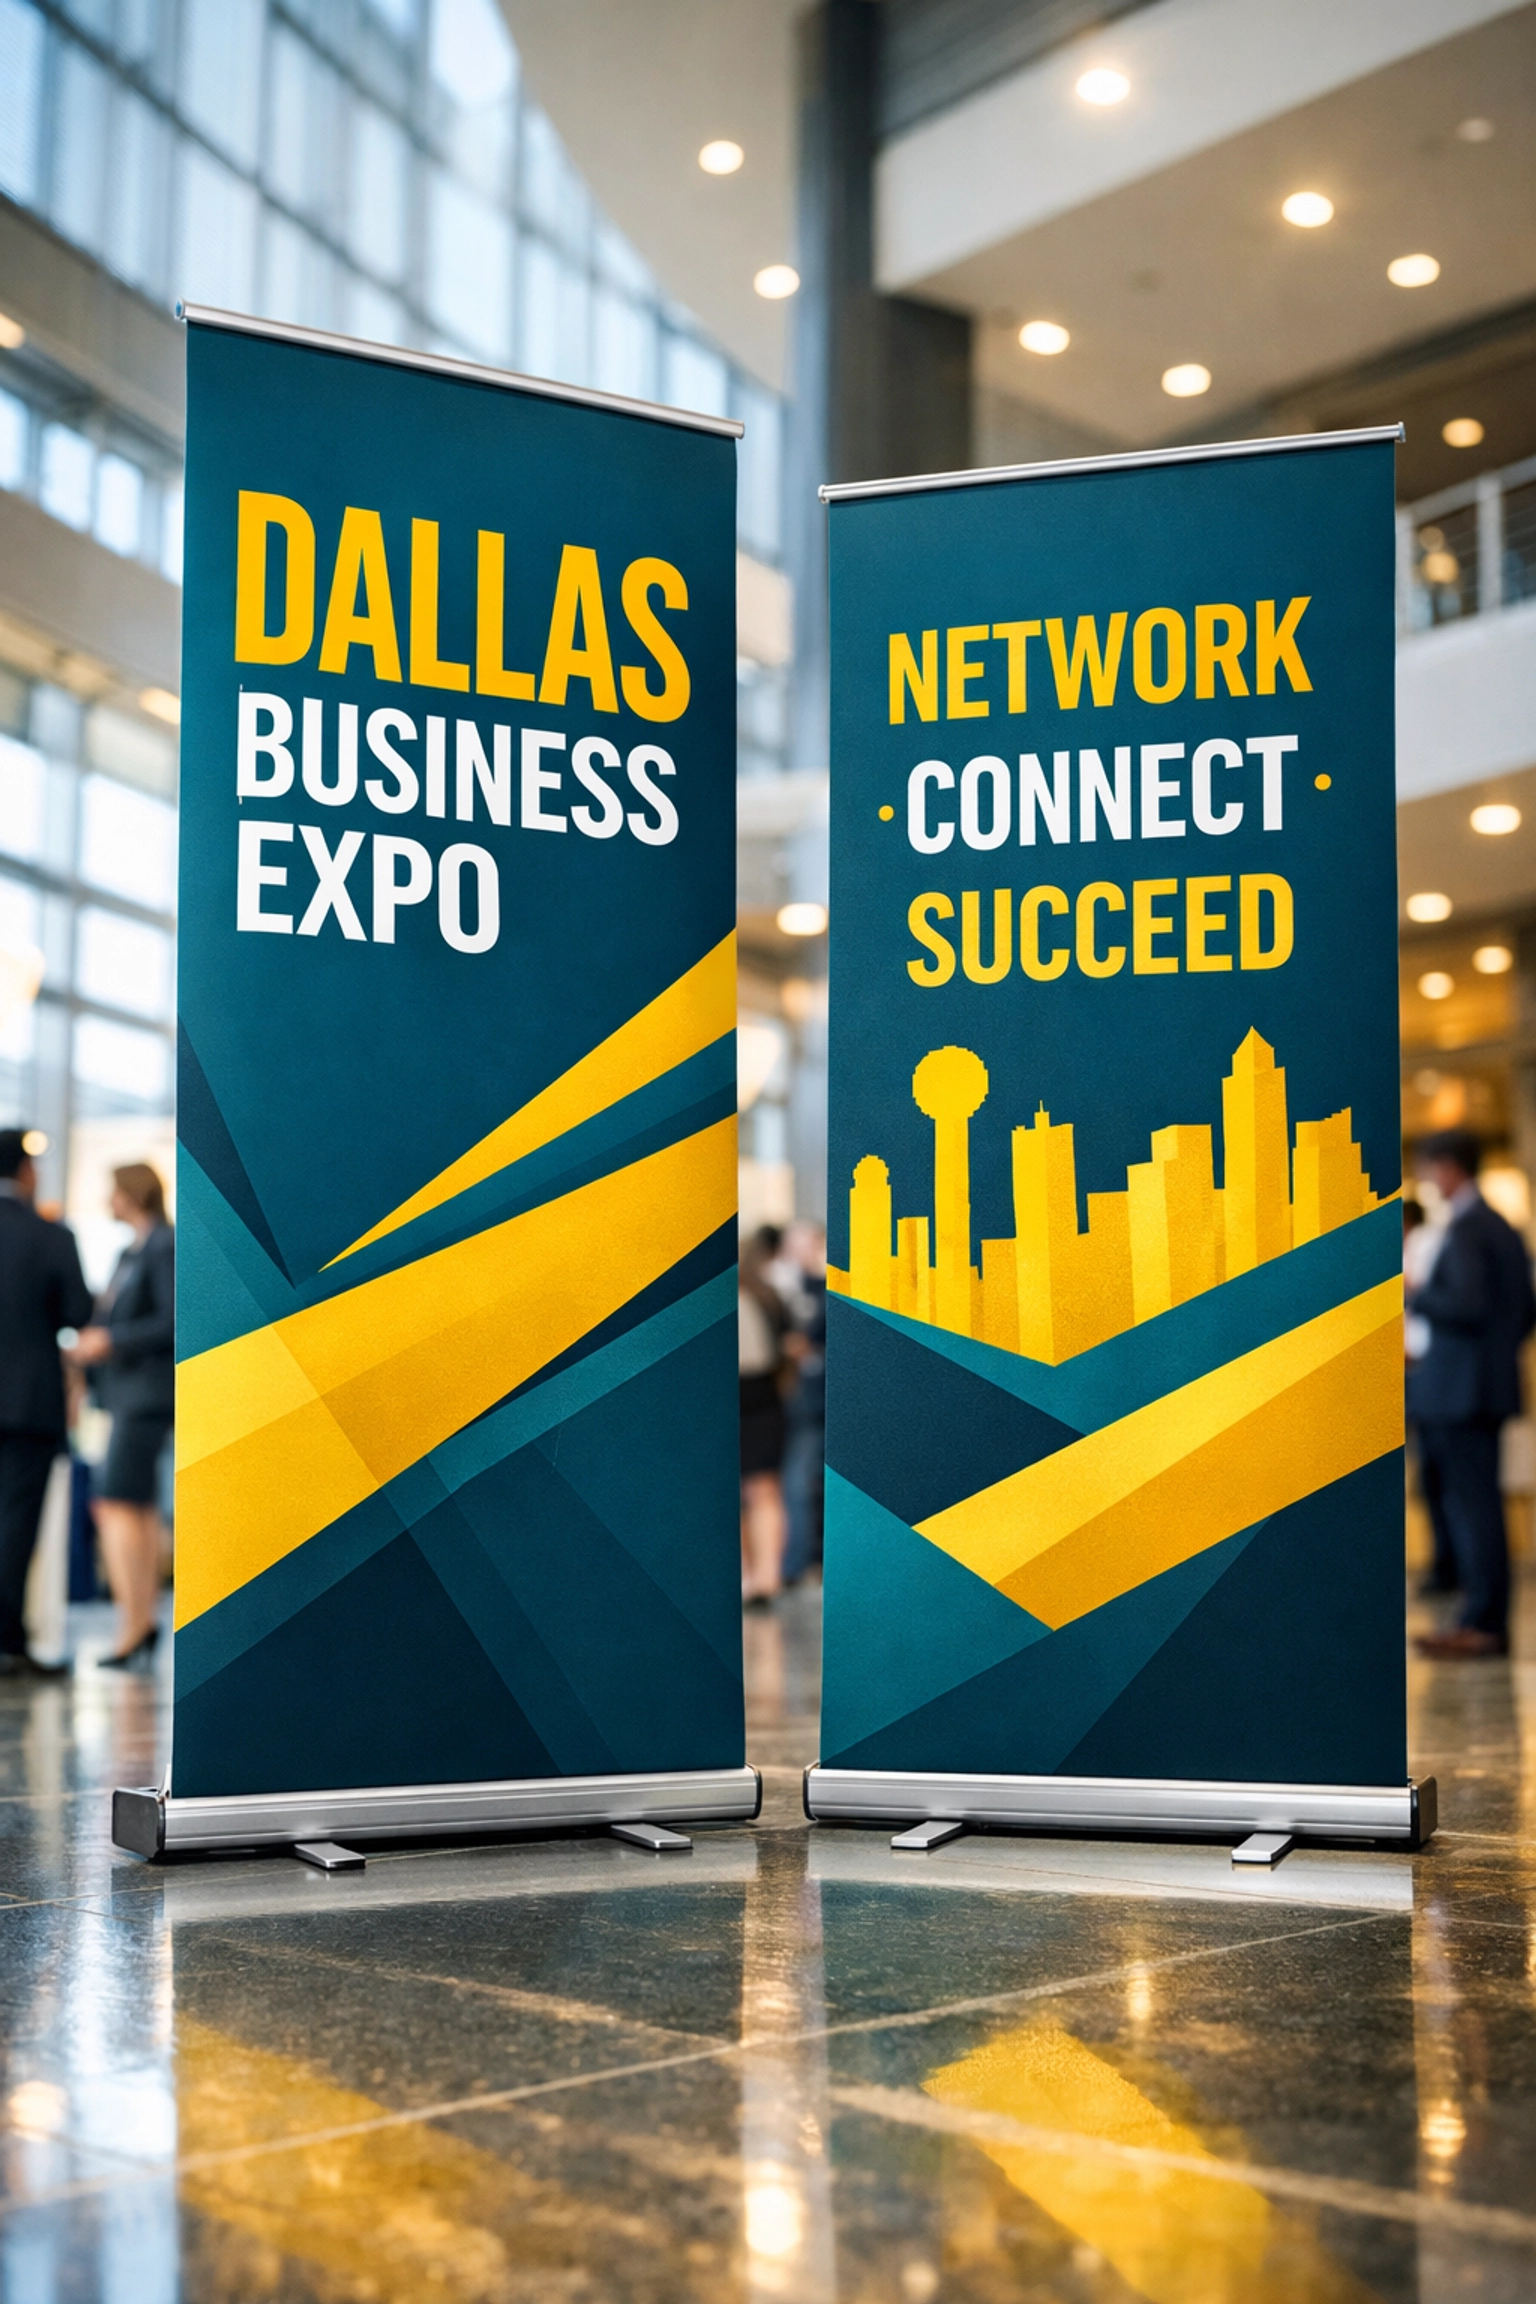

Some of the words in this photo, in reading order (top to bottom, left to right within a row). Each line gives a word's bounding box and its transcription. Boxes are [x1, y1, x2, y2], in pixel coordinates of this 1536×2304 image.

[235, 490, 691, 723] DALLAS
[888, 596, 1314, 725] NETWORK
[236, 692, 679, 846] BUSINESS
[907, 734, 1299, 855] CONNECT
[236, 820, 500, 954] EXPO
[906, 873, 1294, 988] SUCCEED
